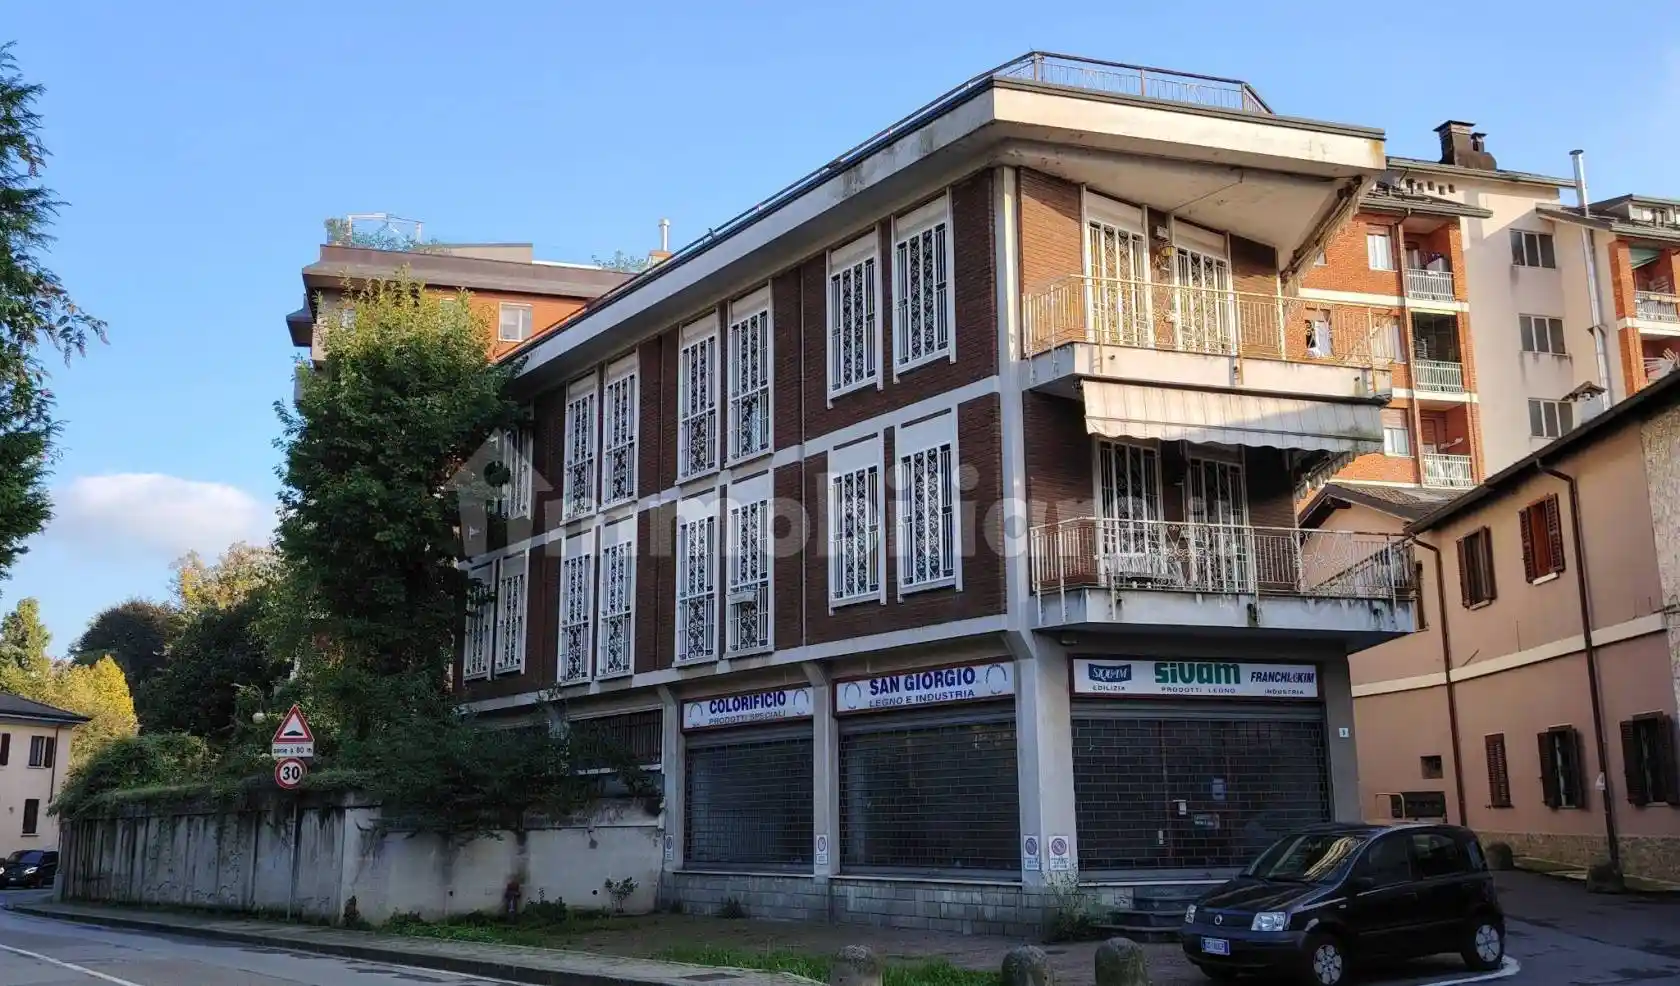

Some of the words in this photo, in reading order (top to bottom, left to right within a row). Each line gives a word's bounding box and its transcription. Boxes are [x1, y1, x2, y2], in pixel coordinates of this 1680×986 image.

[870, 677, 900, 696] SAN
[904, 667, 976, 691] GIORGIO
[709, 691, 787, 714] COLORIFICIO
[869, 694, 903, 707] LEGNO
[906, 694, 913, 703] E
[915, 688, 975, 703] INDUSTRIA
[708, 715, 747, 725] PRODOTTI
[750, 709, 787, 721] SPECIALI
[282, 766, 299, 780] 30
